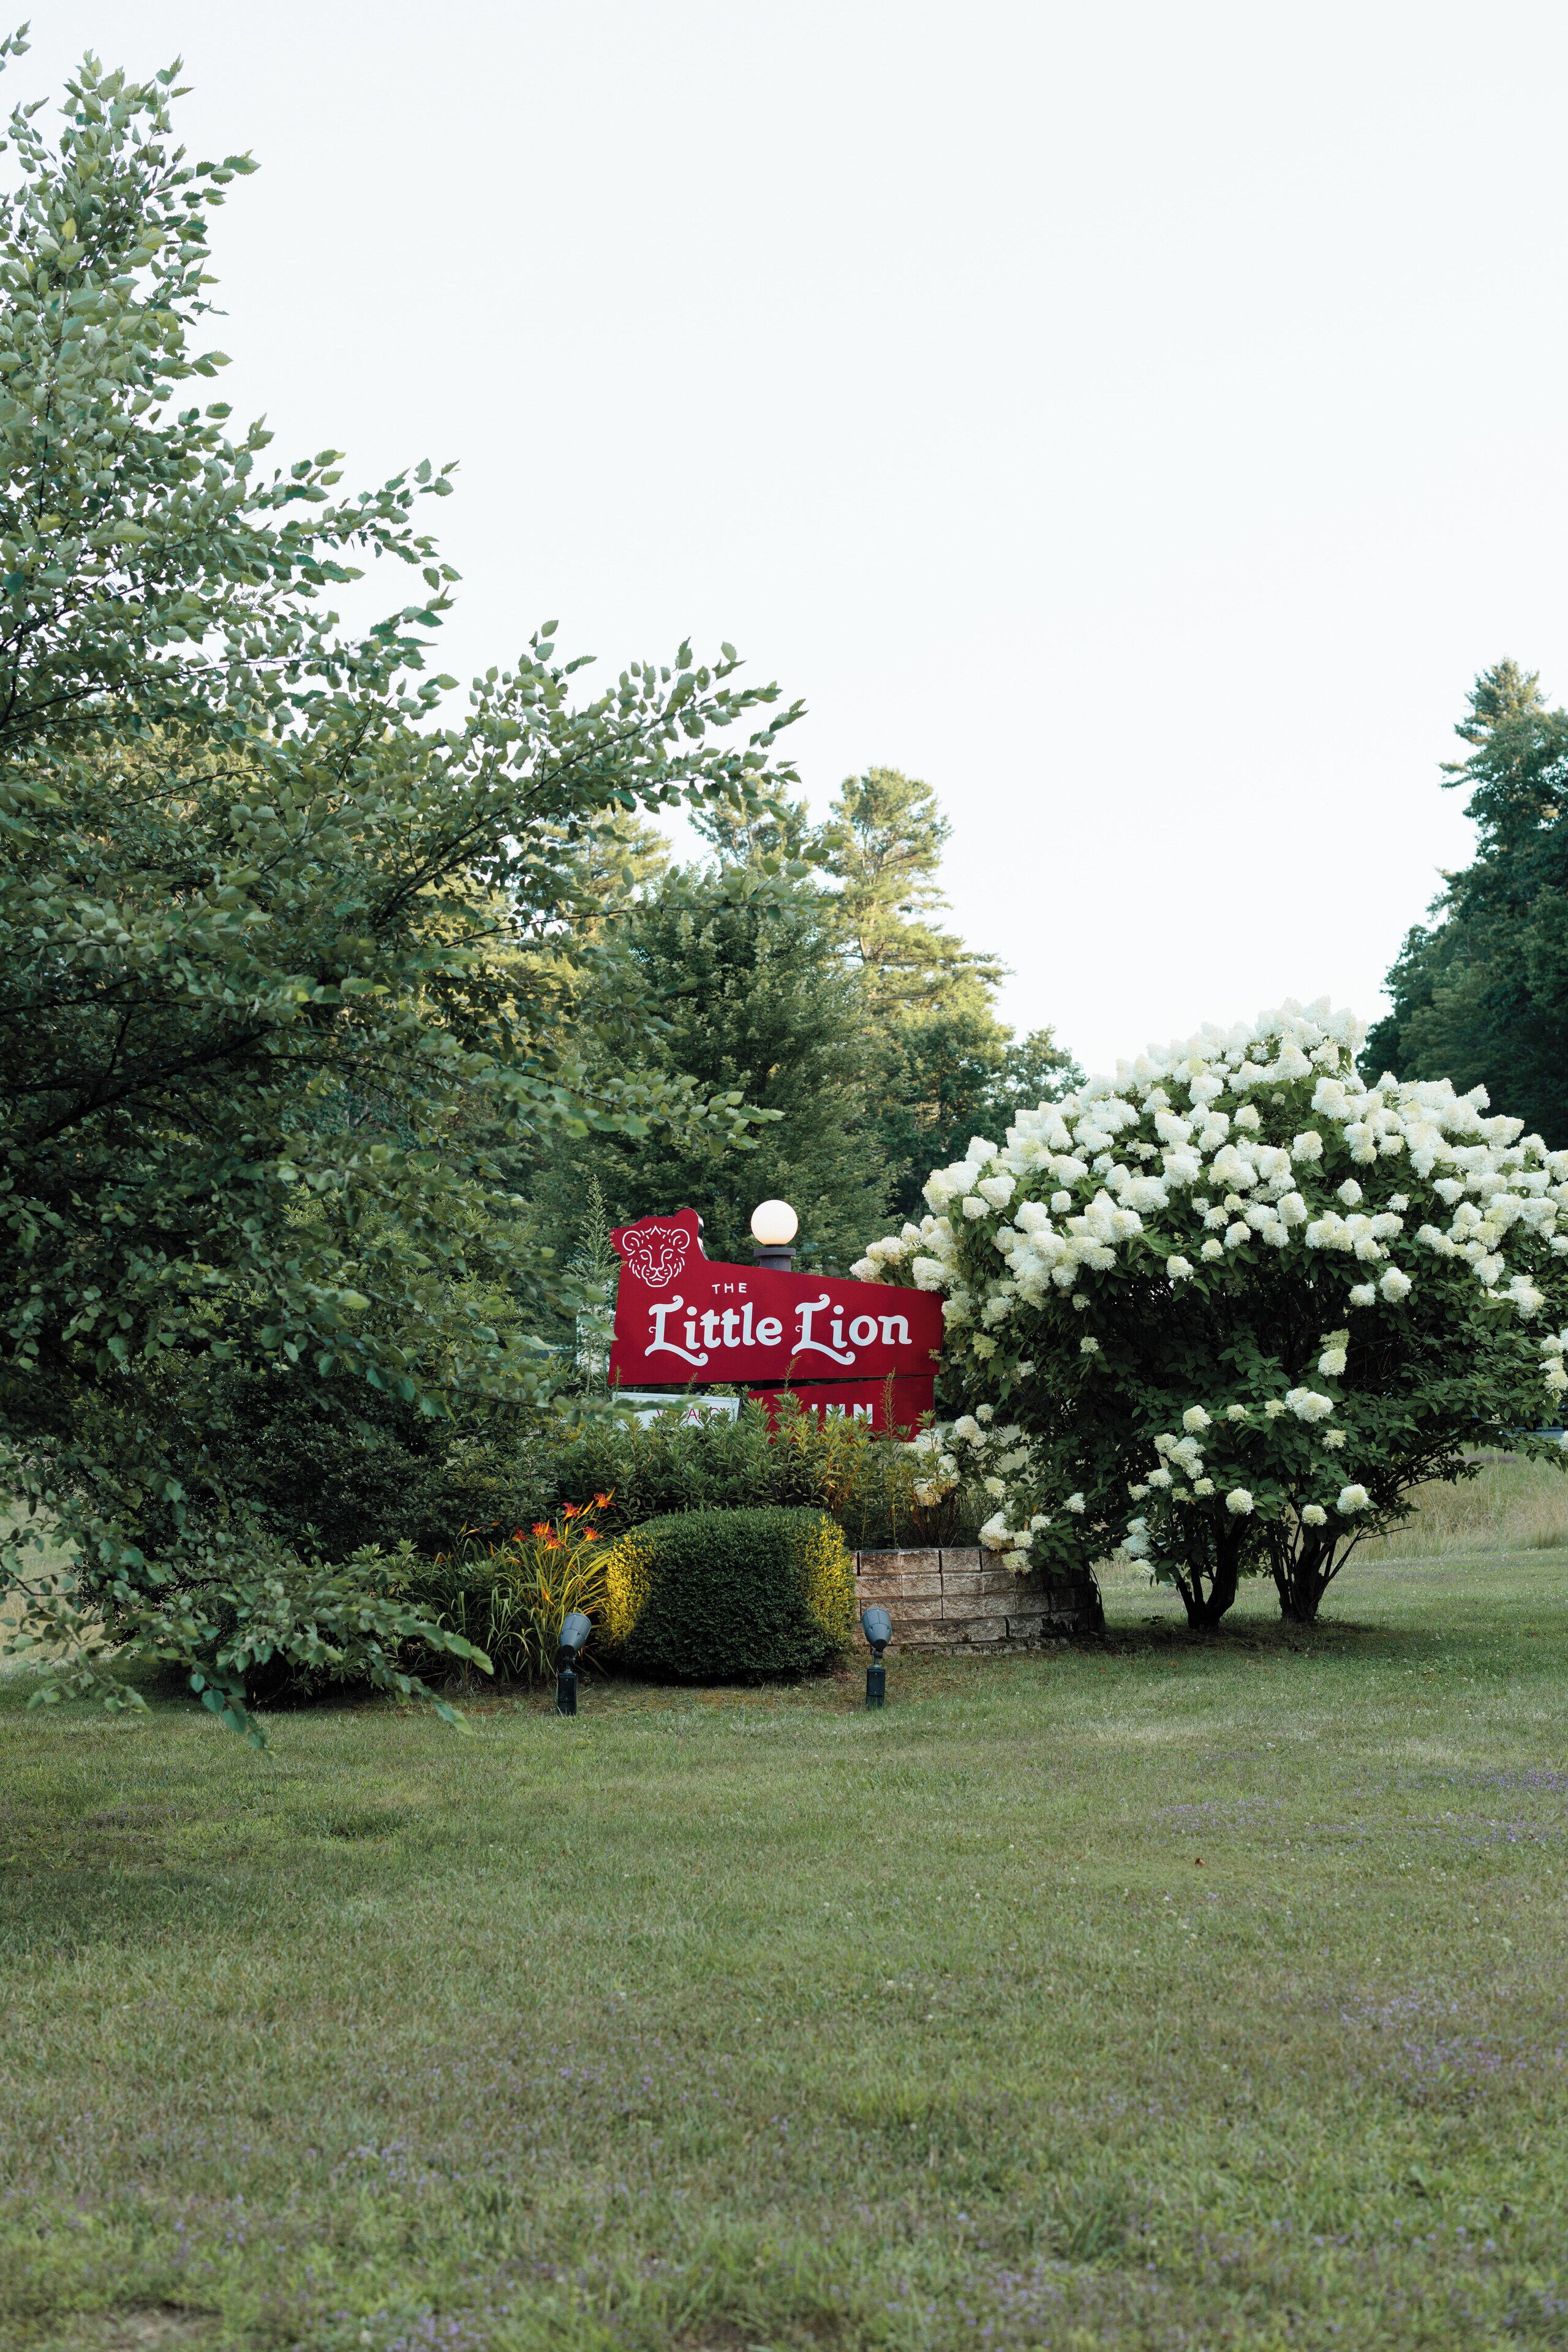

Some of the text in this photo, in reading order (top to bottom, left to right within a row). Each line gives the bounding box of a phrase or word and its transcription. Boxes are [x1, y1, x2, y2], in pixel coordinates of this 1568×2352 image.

[711, 1283, 747, 1294] THE
[645, 1294, 913, 1366] Little Lion
